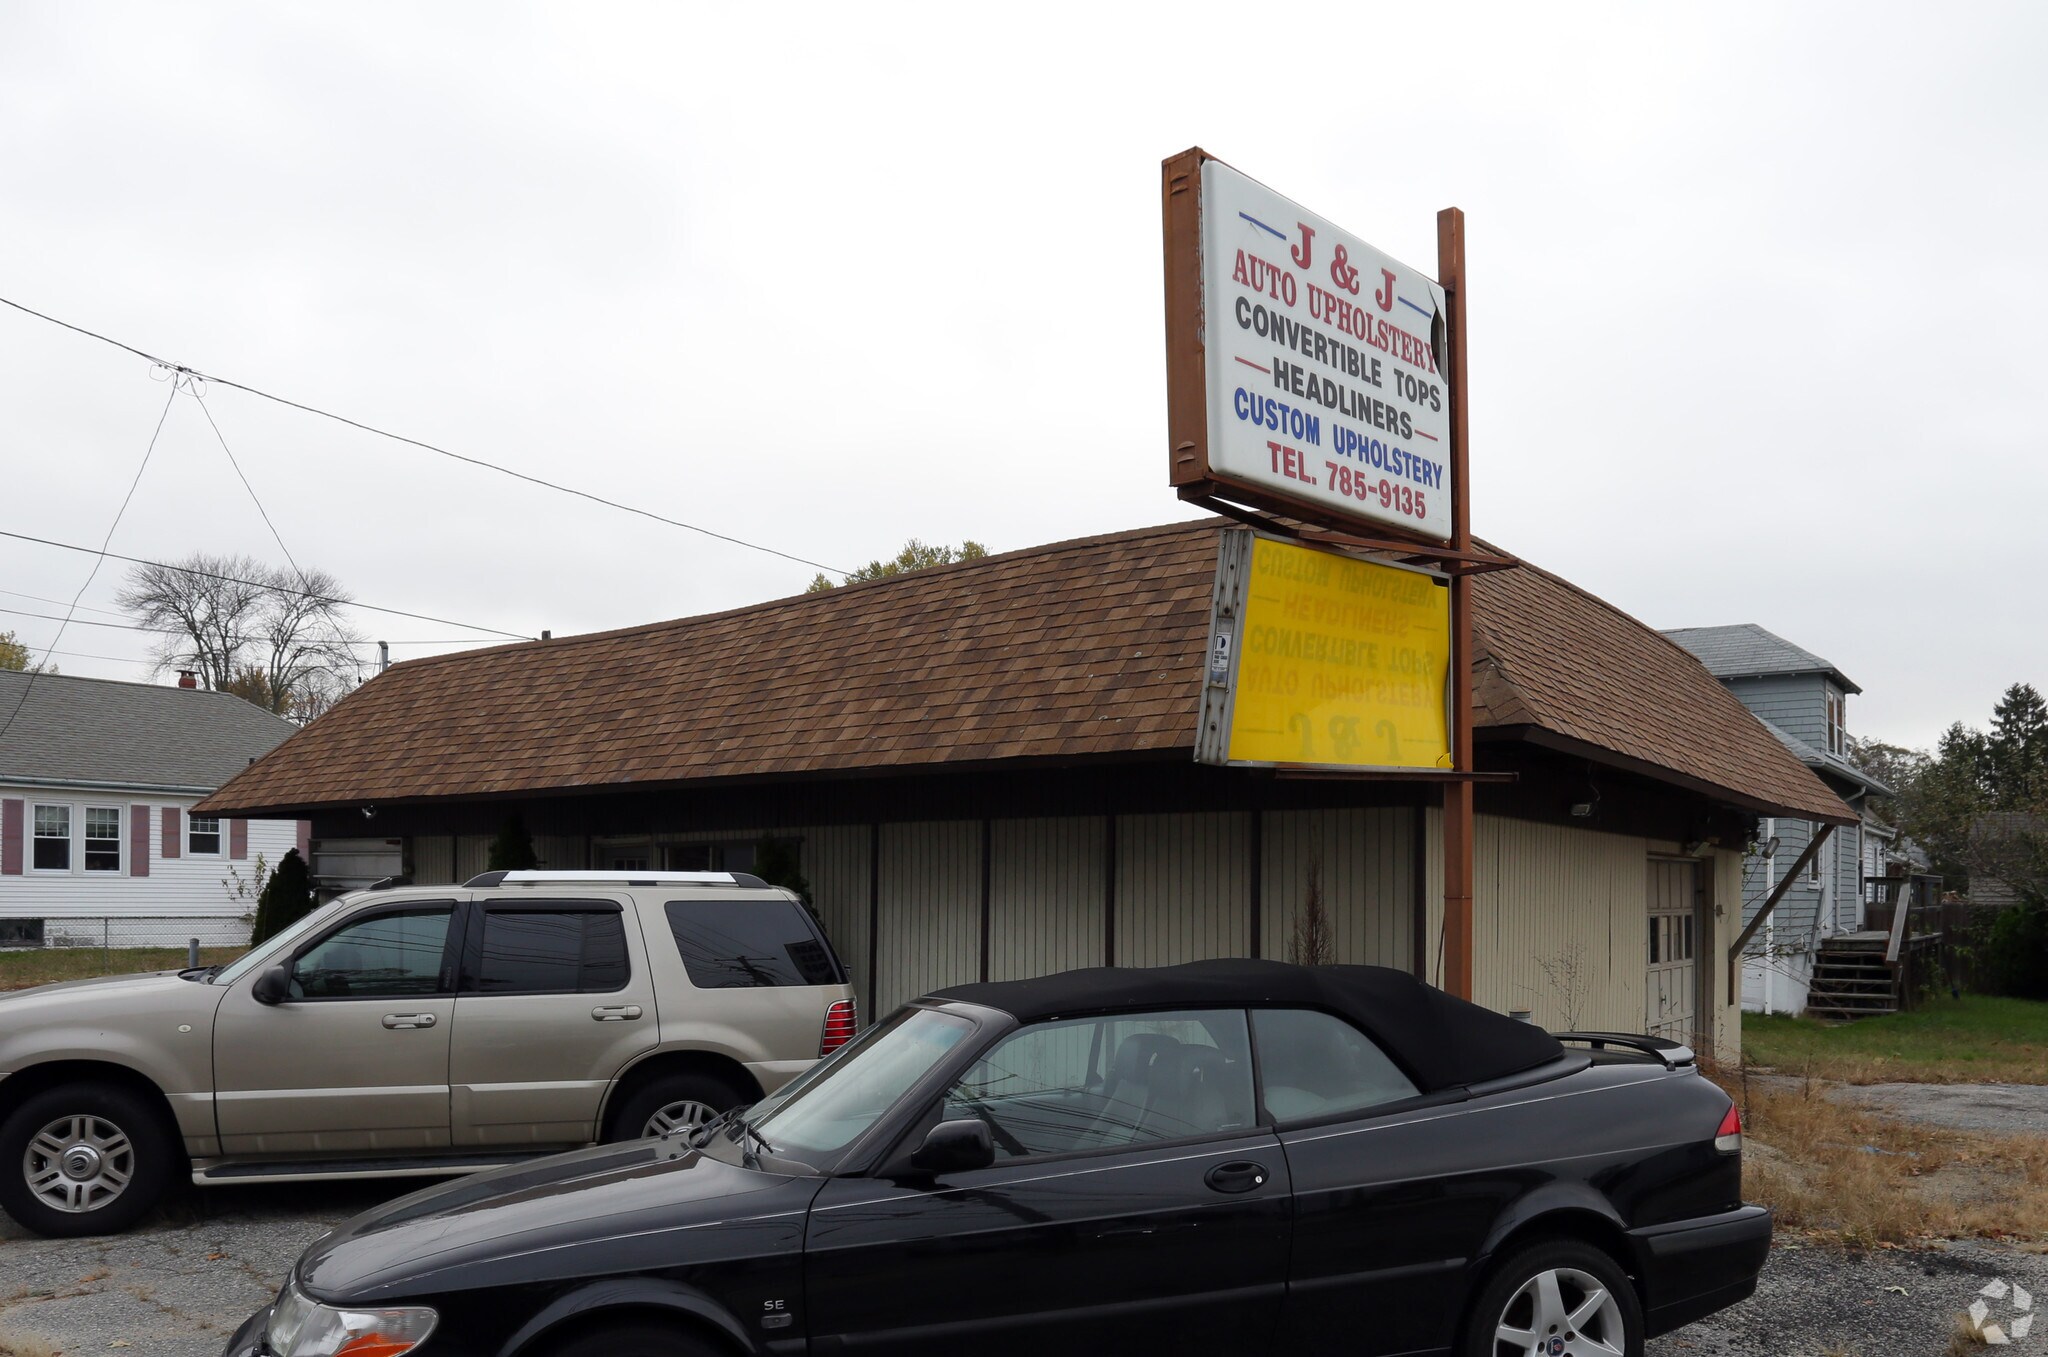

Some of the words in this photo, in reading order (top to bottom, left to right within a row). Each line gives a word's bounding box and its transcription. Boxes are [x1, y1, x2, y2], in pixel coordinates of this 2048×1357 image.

[1232, 248, 1297, 308] AUTO
[1306, 282, 1436, 375] UPHOLSTERY
[1291, 221, 1315, 269] J
[1330, 244, 1360, 296] &
[1375, 268, 1396, 313] J
[1235, 295, 1382, 388] CONVERTIBLE
[1393, 367, 1441, 412] TOPS
[1273, 356, 1412, 440] HEADLINERS
[1234, 387, 1320, 447] CUSTOM
[1333, 424, 1443, 490] UPHOLSTERY
[1267, 440, 1317, 485] TEL.
[1325, 461, 1426, 520] 785-9135
[763, 1299, 785, 1311] SE
